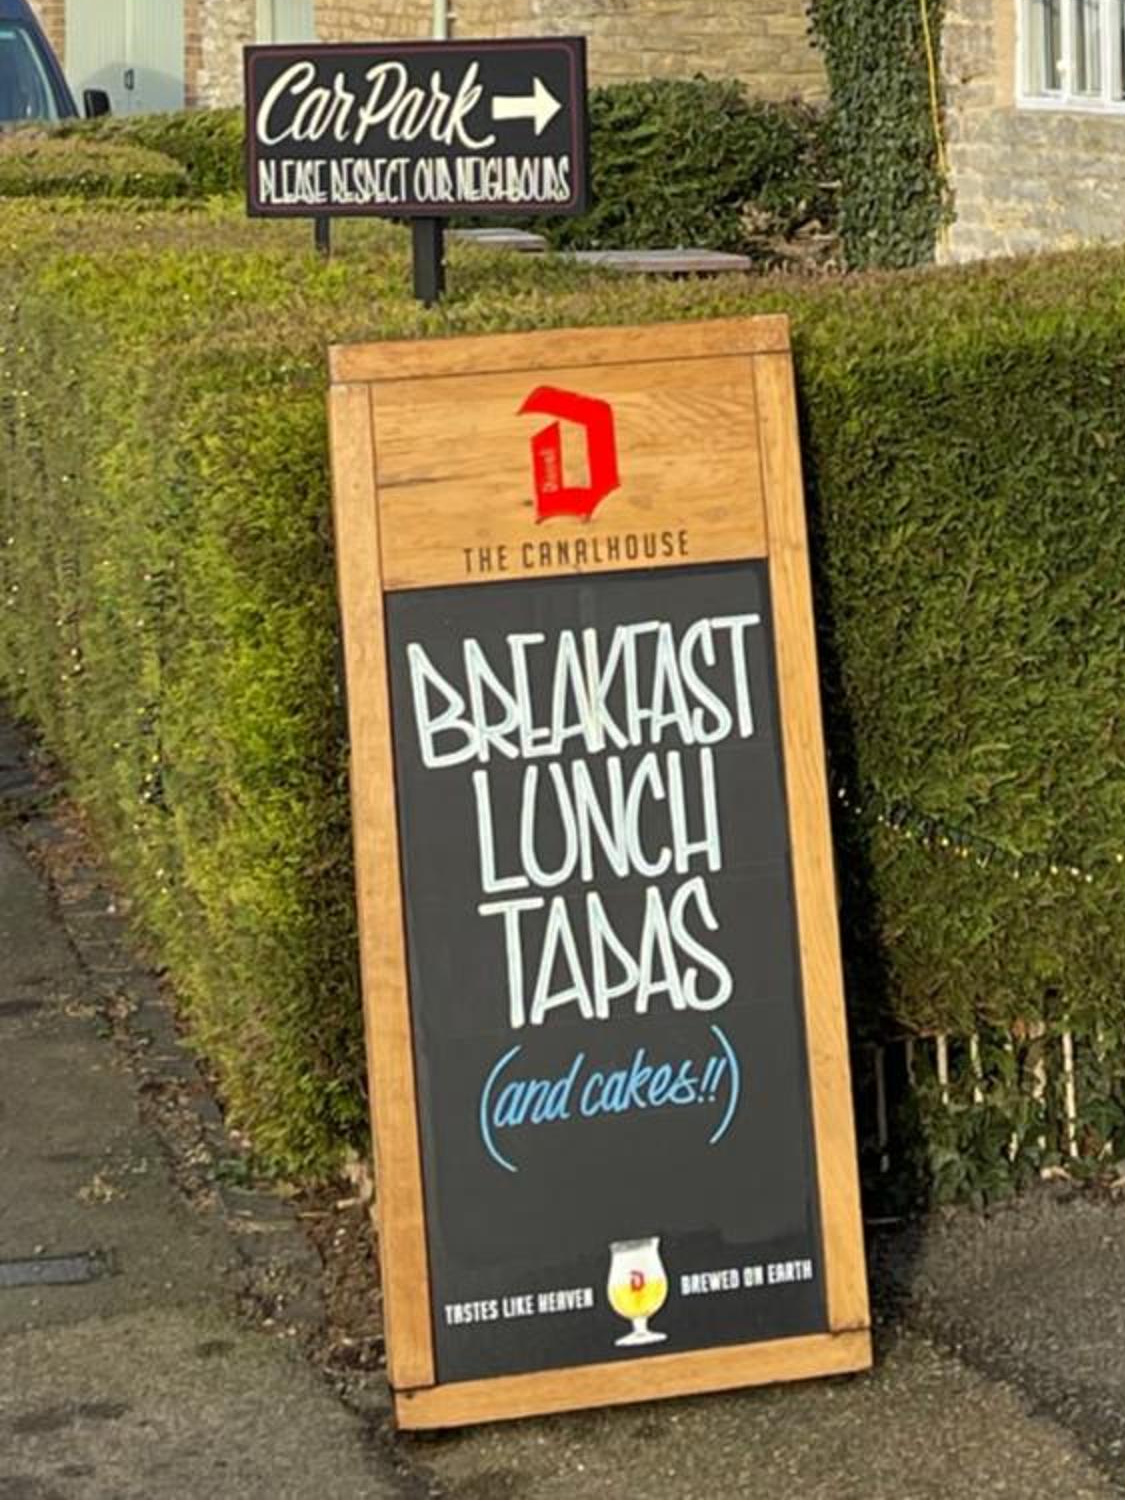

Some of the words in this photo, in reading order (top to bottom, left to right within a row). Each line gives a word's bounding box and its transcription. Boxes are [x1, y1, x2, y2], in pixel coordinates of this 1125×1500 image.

[256, 61, 355, 146] Car
[353, 61, 496, 149] Park
[258, 159, 327, 204] PLEASE
[330, 157, 411, 204] RESPECT
[413, 157, 454, 202] OUR
[455, 155, 571, 202] NEIGHBOURS
[463, 545, 508, 573] THE
[522, 530, 690, 569] CANALHOUSE
[406, 613, 761, 770] BREAKFAST
[472, 745, 723, 893] LUNCH
[477, 875, 734, 1029] TAPAS
[445, 1303, 499, 1326] TASTES
[502, 1297, 536, 1319] LIKE
[538, 1288, 594, 1313] HEAVEN
[680, 1269, 740, 1296] BREWED
[743, 1269, 765, 1288] ON
[767, 1259, 813, 1284] EARTH
